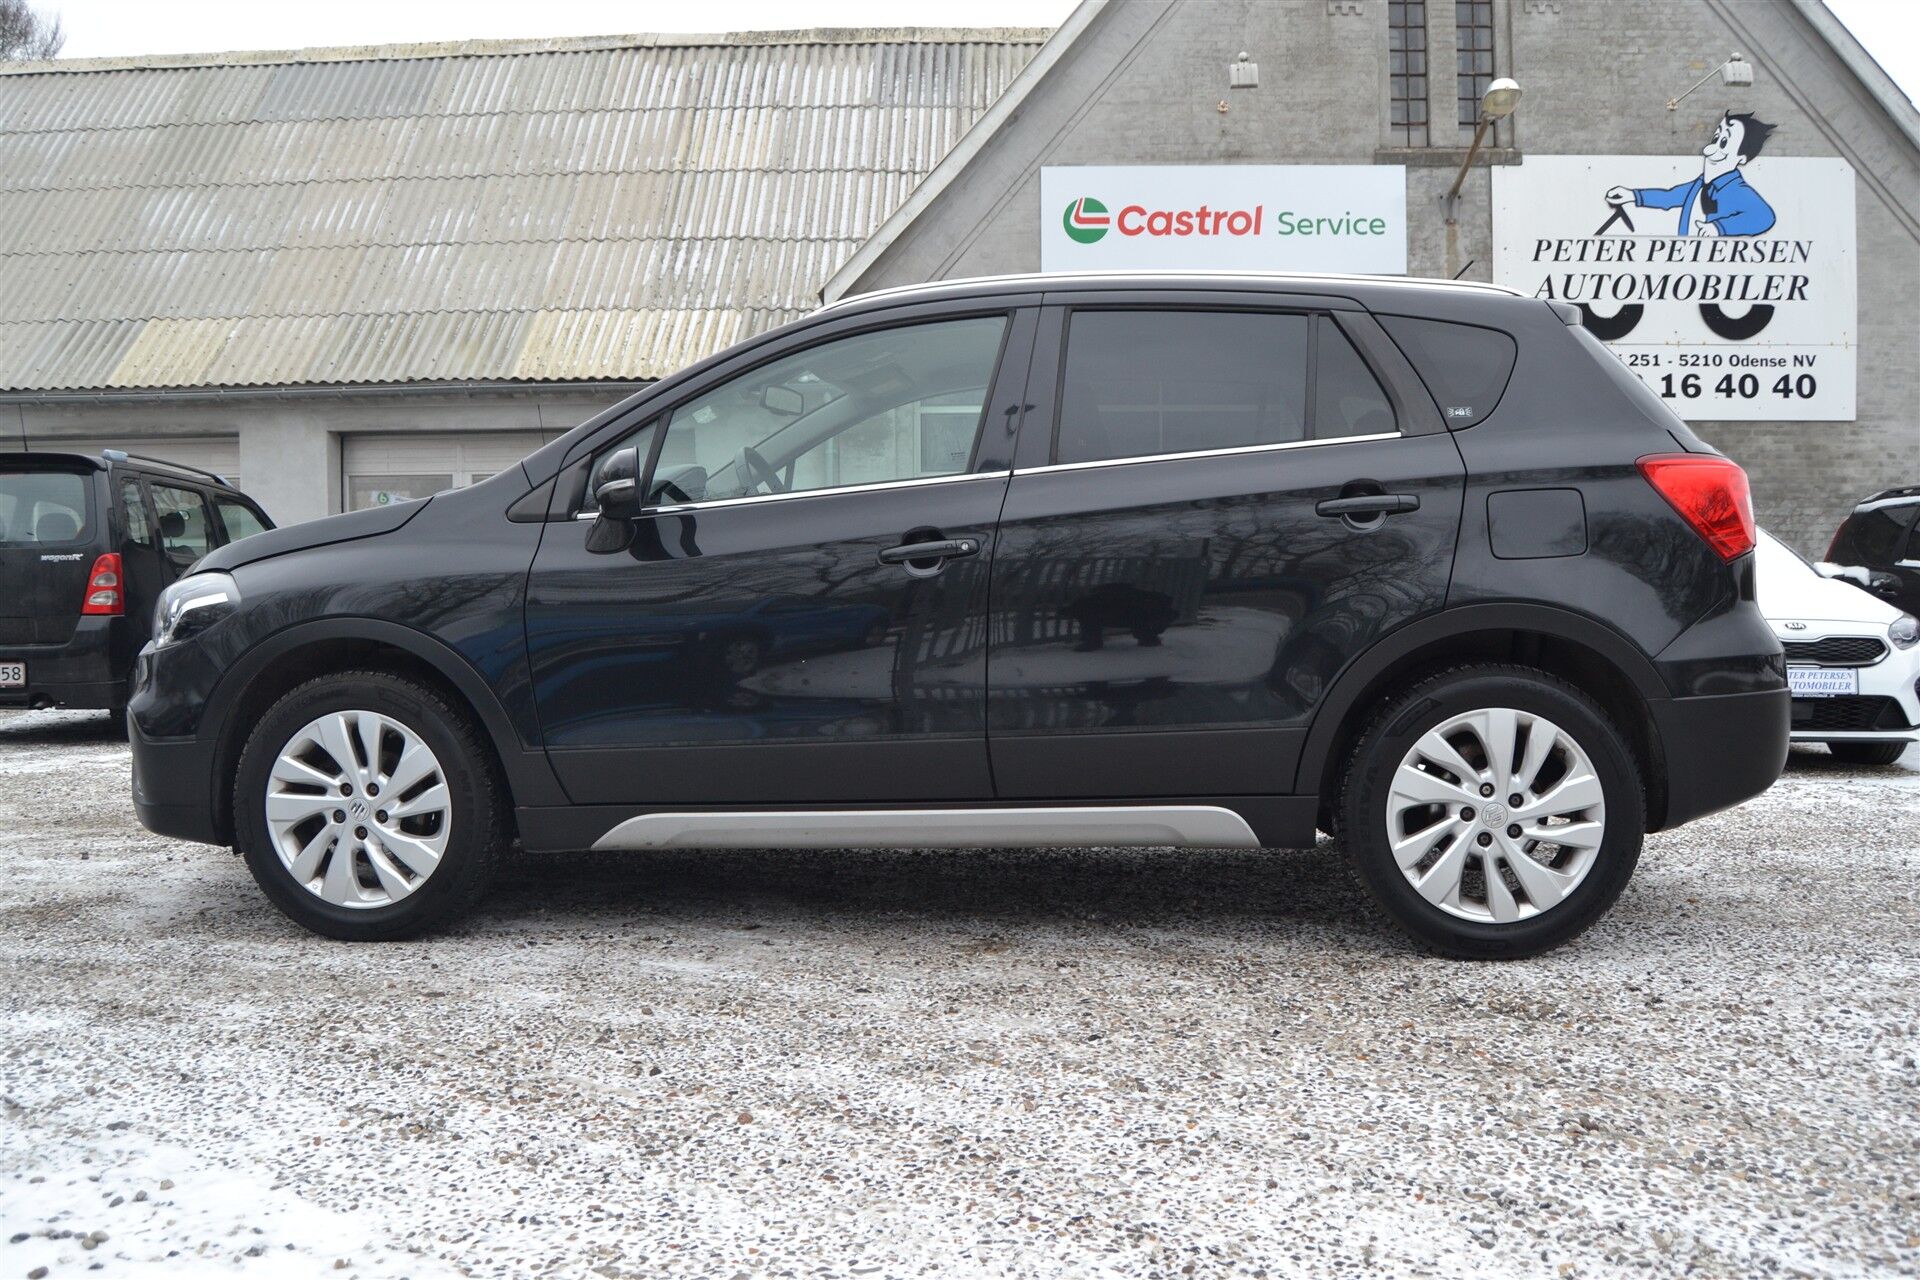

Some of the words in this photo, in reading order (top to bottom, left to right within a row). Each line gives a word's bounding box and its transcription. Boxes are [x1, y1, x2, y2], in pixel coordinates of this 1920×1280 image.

[1117, 205, 1263, 236] Castrol
[1278, 211, 1386, 236] Service
[1532, 238, 1636, 262] PETER
[1646, 239, 1813, 263] PETERSEN
[1534, 273, 1810, 301] AUTOMOBILER
[1629, 354, 1660, 367] 251
[1679, 354, 1722, 367] 5210
[1729, 354, 1787, 367] Odense
[1793, 354, 1817, 367] NV
[1661, 373, 1702, 398] 16
[1714, 373, 1759, 398] 40
[1772, 373, 1817, 399] 40
[1791, 681, 1852, 690] TOMOBILER
[1807, 671, 1853, 679] PETERSEN
